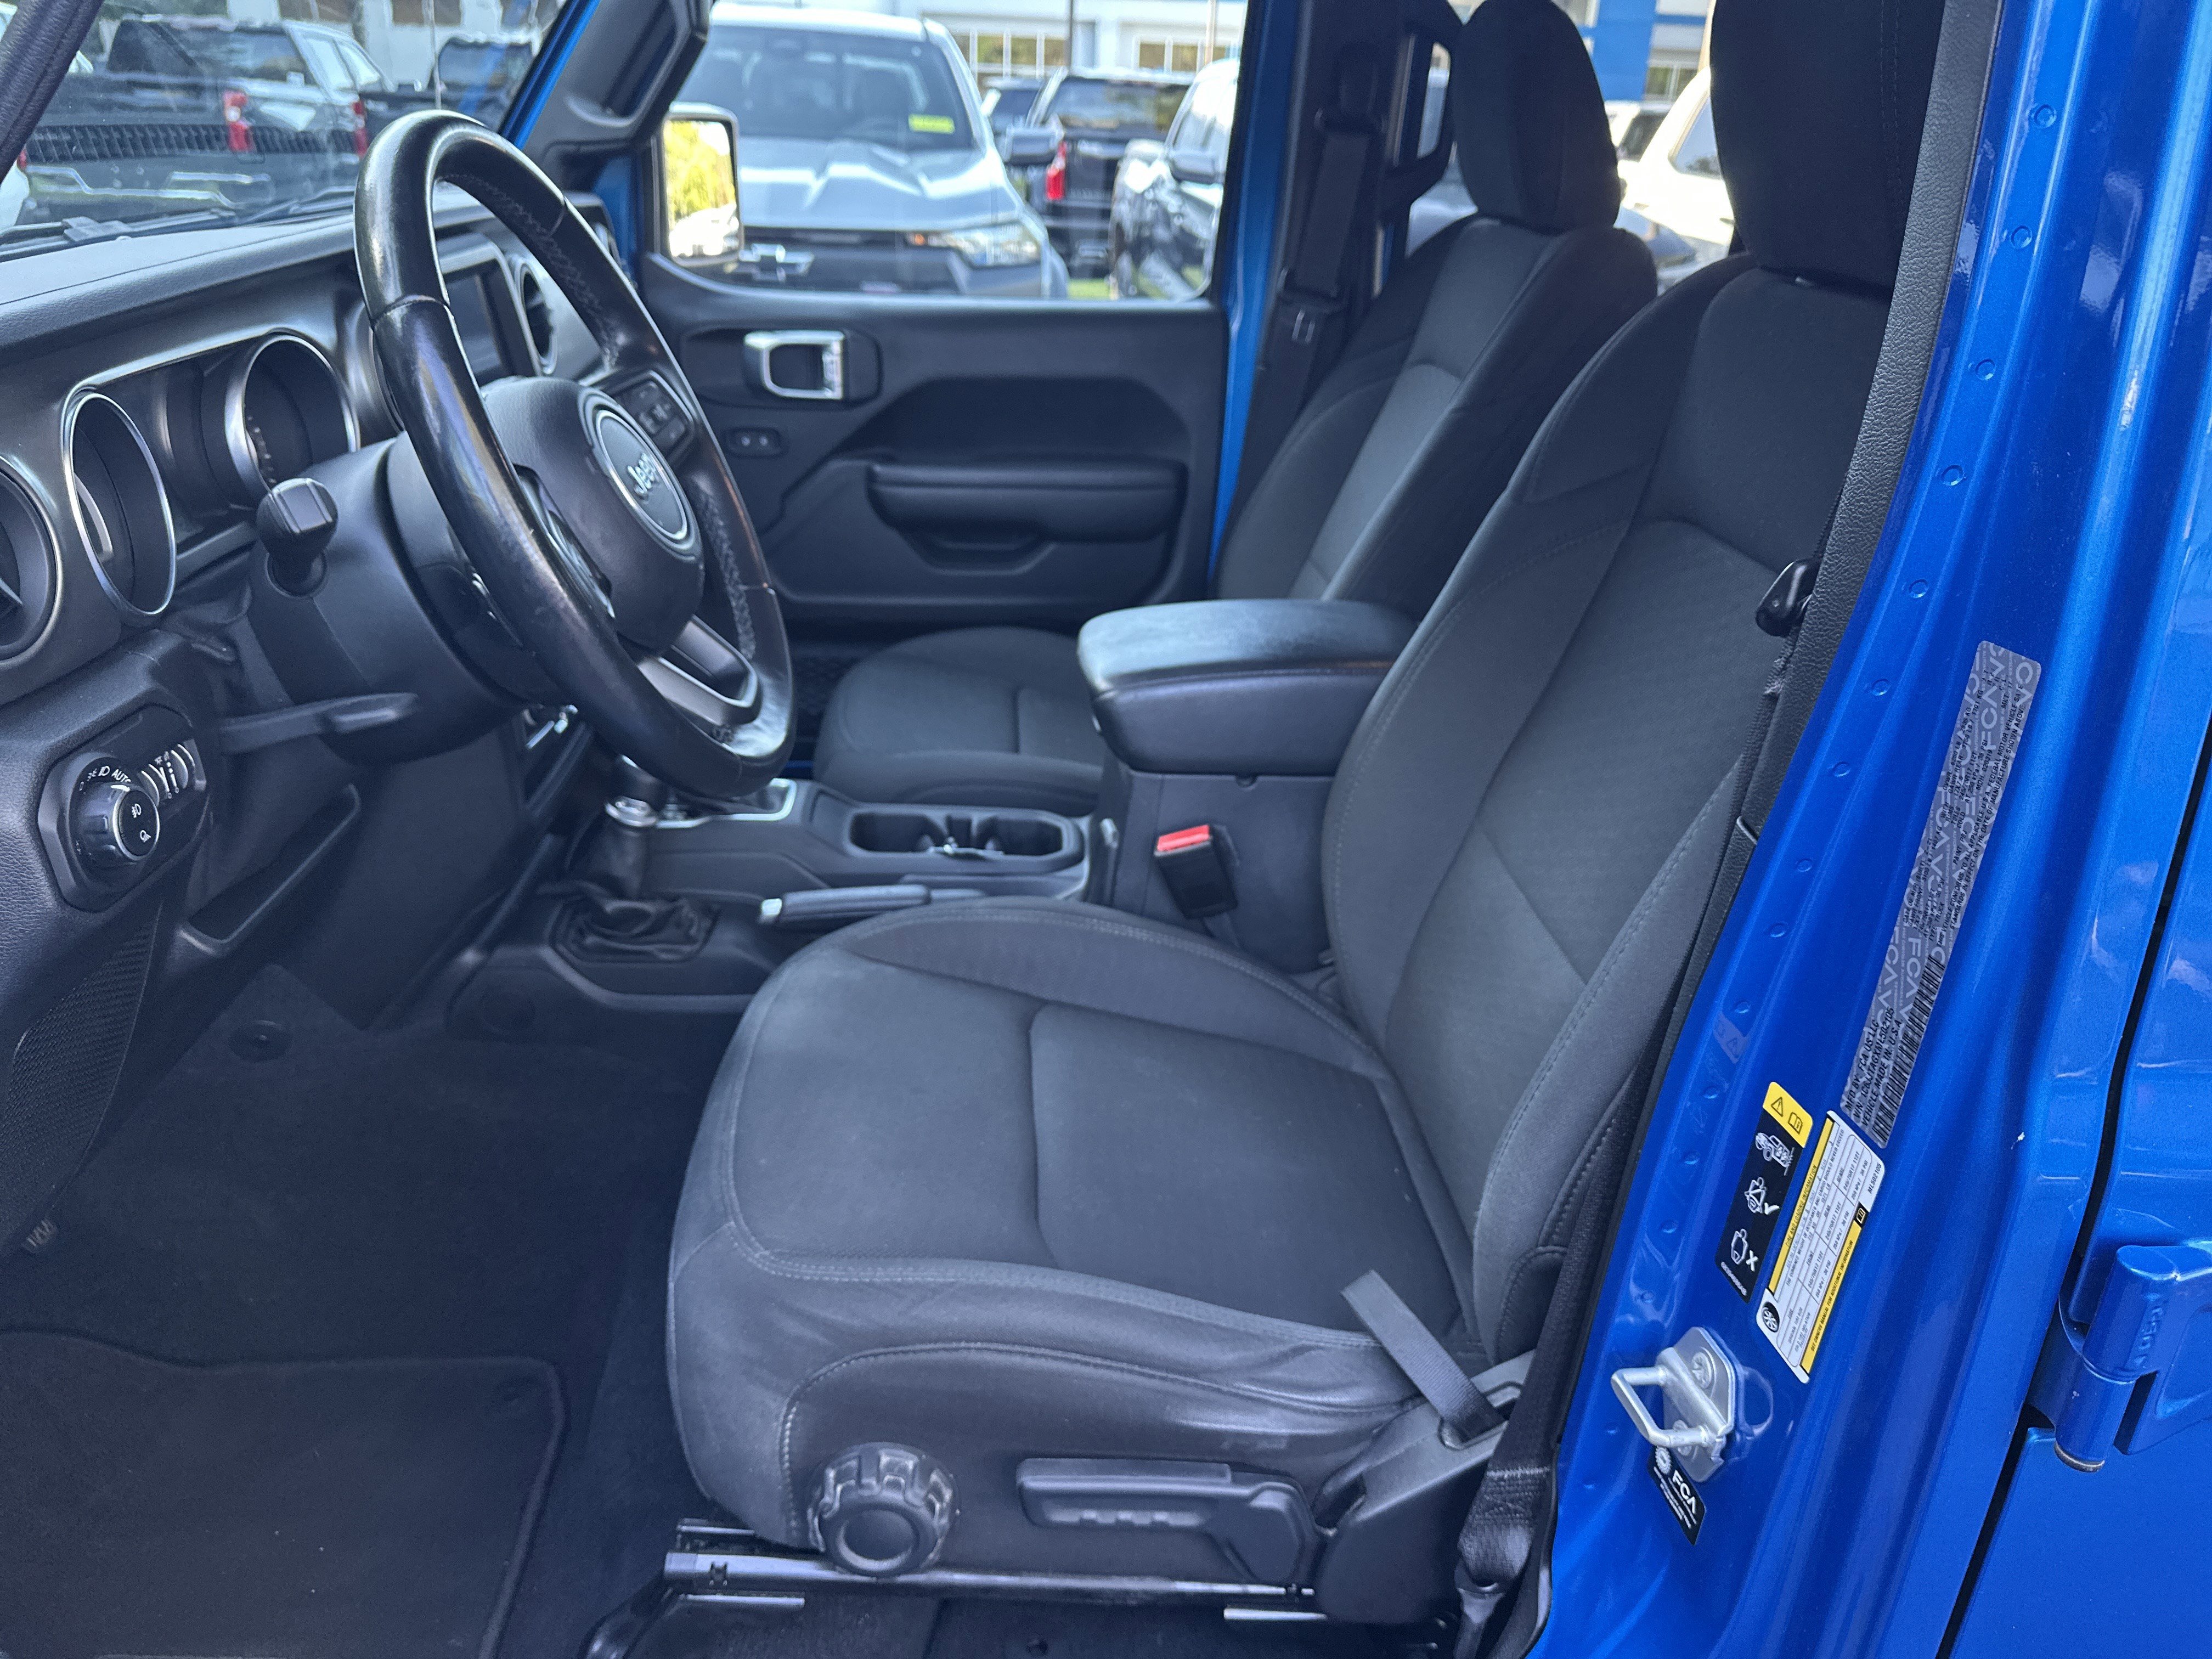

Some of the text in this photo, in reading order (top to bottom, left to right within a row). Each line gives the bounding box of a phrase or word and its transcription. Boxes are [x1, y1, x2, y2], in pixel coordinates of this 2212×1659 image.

[627, 453, 659, 495] Jeep
[1971, 699, 1980, 715] 1701
[1976, 689, 1983, 699] KG
[2004, 702, 2018, 732] VEHICLE
[1968, 750, 1978, 766] 112T
[1996, 731, 2008, 757] MOTOR
[1963, 793, 1971, 804] AT
[1971, 768, 1979, 781] kPa
[1980, 738, 1988, 751] PSI
[1987, 757, 2001, 788] FEDERAL
[1940, 800, 1950, 819] WITH
[1945, 804, 1955, 822] RIMS
[1949, 703, 2025, 930] STANDARDS IN EFFECT ON THE DATE OF MANUFACTURE SHOWN ABOVE
[1950, 805, 1961, 826] TIRES
[1934, 900, 1945, 923] TRUCK
[1981, 748, 1993, 772] 020319
[1967, 809, 1984, 849] APPLICABLE
[1960, 861, 1968, 871] TO
[1963, 848, 1972, 862] ALL
[1922, 928, 1929, 939] AT
[1956, 810, 1966, 829] COLD
[1949, 871, 1965, 907] CONFORMS
[1941, 906, 1953, 933] VEHICLE
[1936, 932, 1945, 949] THIS
[1867, 1018, 1880, 1039] LLC
[1859, 1003, 1895, 1099] 1C6JJTAGXML502105
[1863, 1036, 1874, 1053] US
[1857, 1051, 1869, 1072] FCA
[1844, 1087, 1857, 1113] MFD
[1861, 1087, 1879, 1128] VEHICLE
[1873, 1059, 1888, 1090] MADE
[1804, 1205, 1817, 1233] OCCUPANTS
[1817, 1178, 1826, 1197] CARGO
[1829, 1146, 1838, 1163] NEVER
[1835, 1127, 1844, 1148] EXCEED
[1867, 1161, 1882, 1195] ML502105
[1793, 1199, 1804, 1224] LOADING
[1801, 1163, 1817, 1201] INFORMATION
[1820, 1305, 1829, 1325] MANUAL
[1830, 1269, 1842, 1297] ADDITIONAL
[1839, 1238, 1853, 1272] INFORMATION
[1672, 1469, 1697, 1515] FCA
